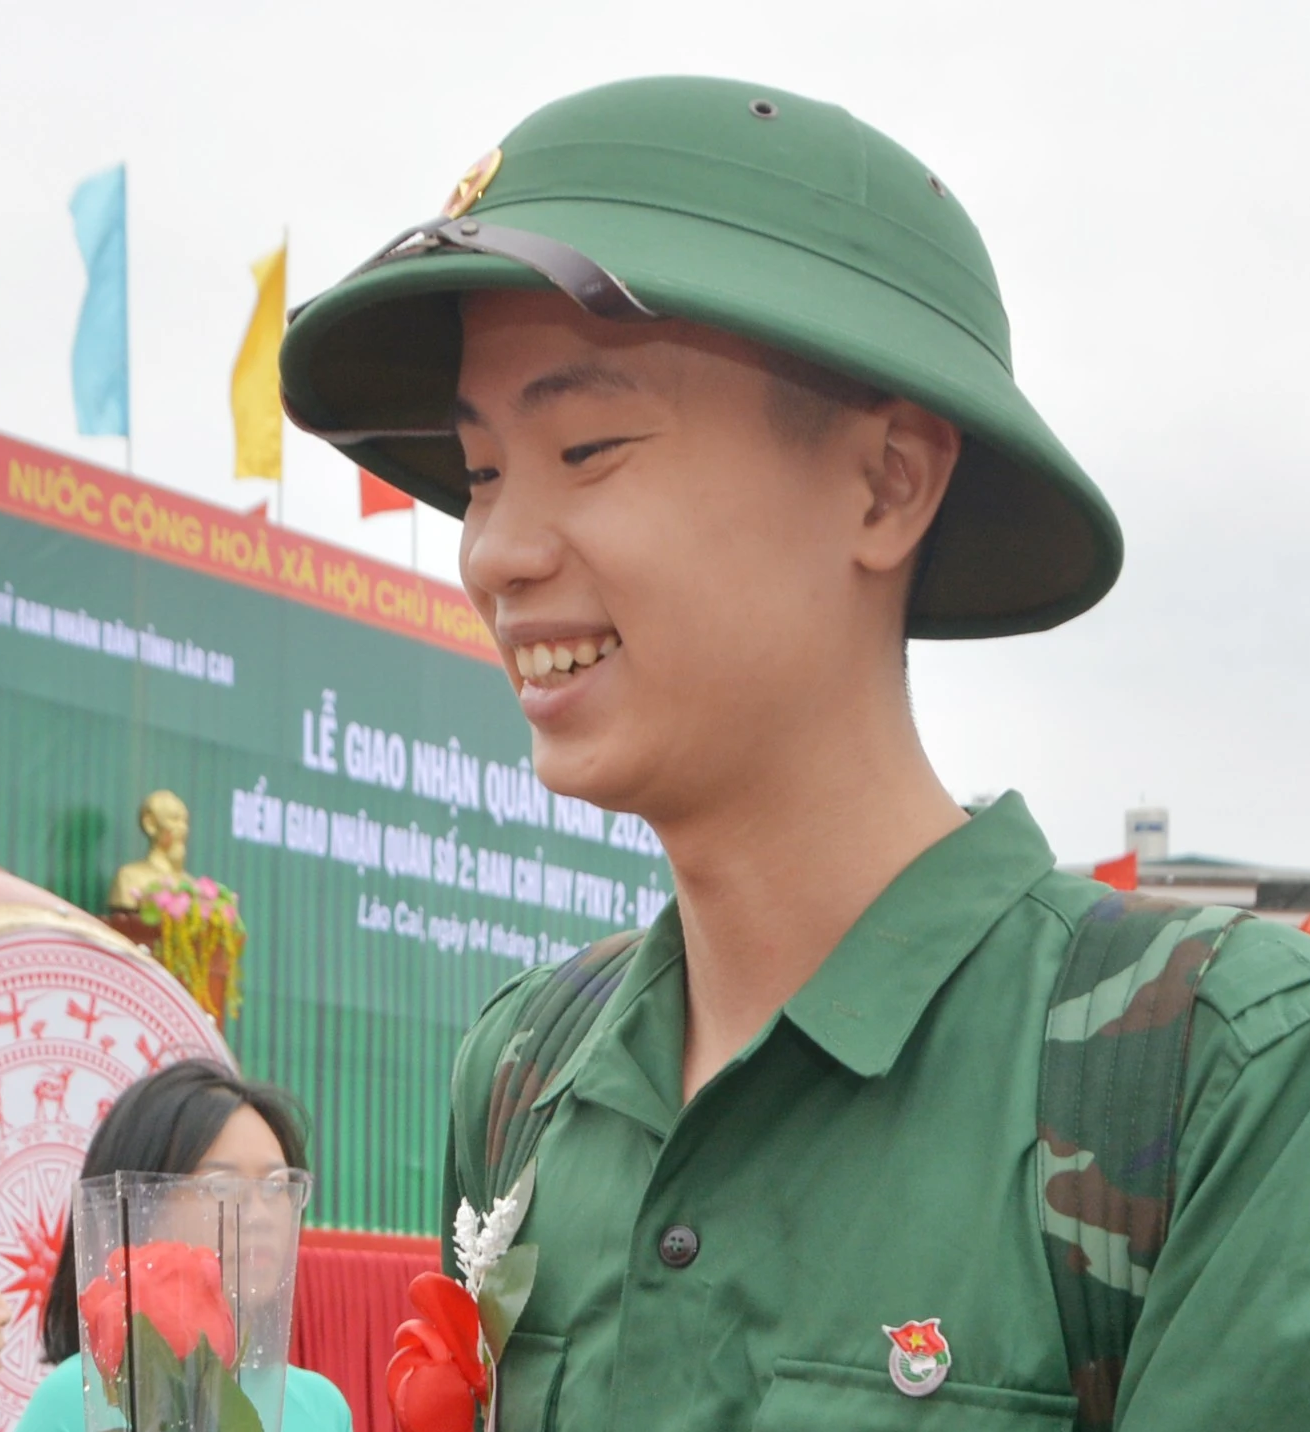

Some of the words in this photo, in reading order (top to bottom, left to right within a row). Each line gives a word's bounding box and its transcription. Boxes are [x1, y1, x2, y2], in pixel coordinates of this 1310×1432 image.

[8, 457, 103, 526] NƯỚC
[109, 492, 203, 555] CỘNG
[279, 545, 317, 593] XÃ
[323, 560, 369, 611] HỘI
[375, 579, 427, 628] CHỦ
[432, 598, 495, 648] NGH
[176, 638, 206, 680] LÀO
[207, 650, 234, 687] CAI
[303, 688, 338, 774] LỄ
[344, 721, 406, 791] GIAO
[412, 735, 479, 818] NHẬN
[484, 756, 548, 829] QUÂN
[232, 775, 283, 846] ĐIỂM
[285, 800, 328, 857] GIAO
[330, 808, 381, 877] NHẬN
[384, 821, 432, 881] QUÂN
[433, 825, 457, 886] SỐ
[477, 847, 512, 898] BAN
[514, 845, 542, 903] CHỈ
[613, 880, 626, 925] 2
[357, 892, 391, 931] Lào
[394, 900, 425, 943] Cai,
[429, 911, 467, 955] ngày
[490, 923, 536, 968] tháng
